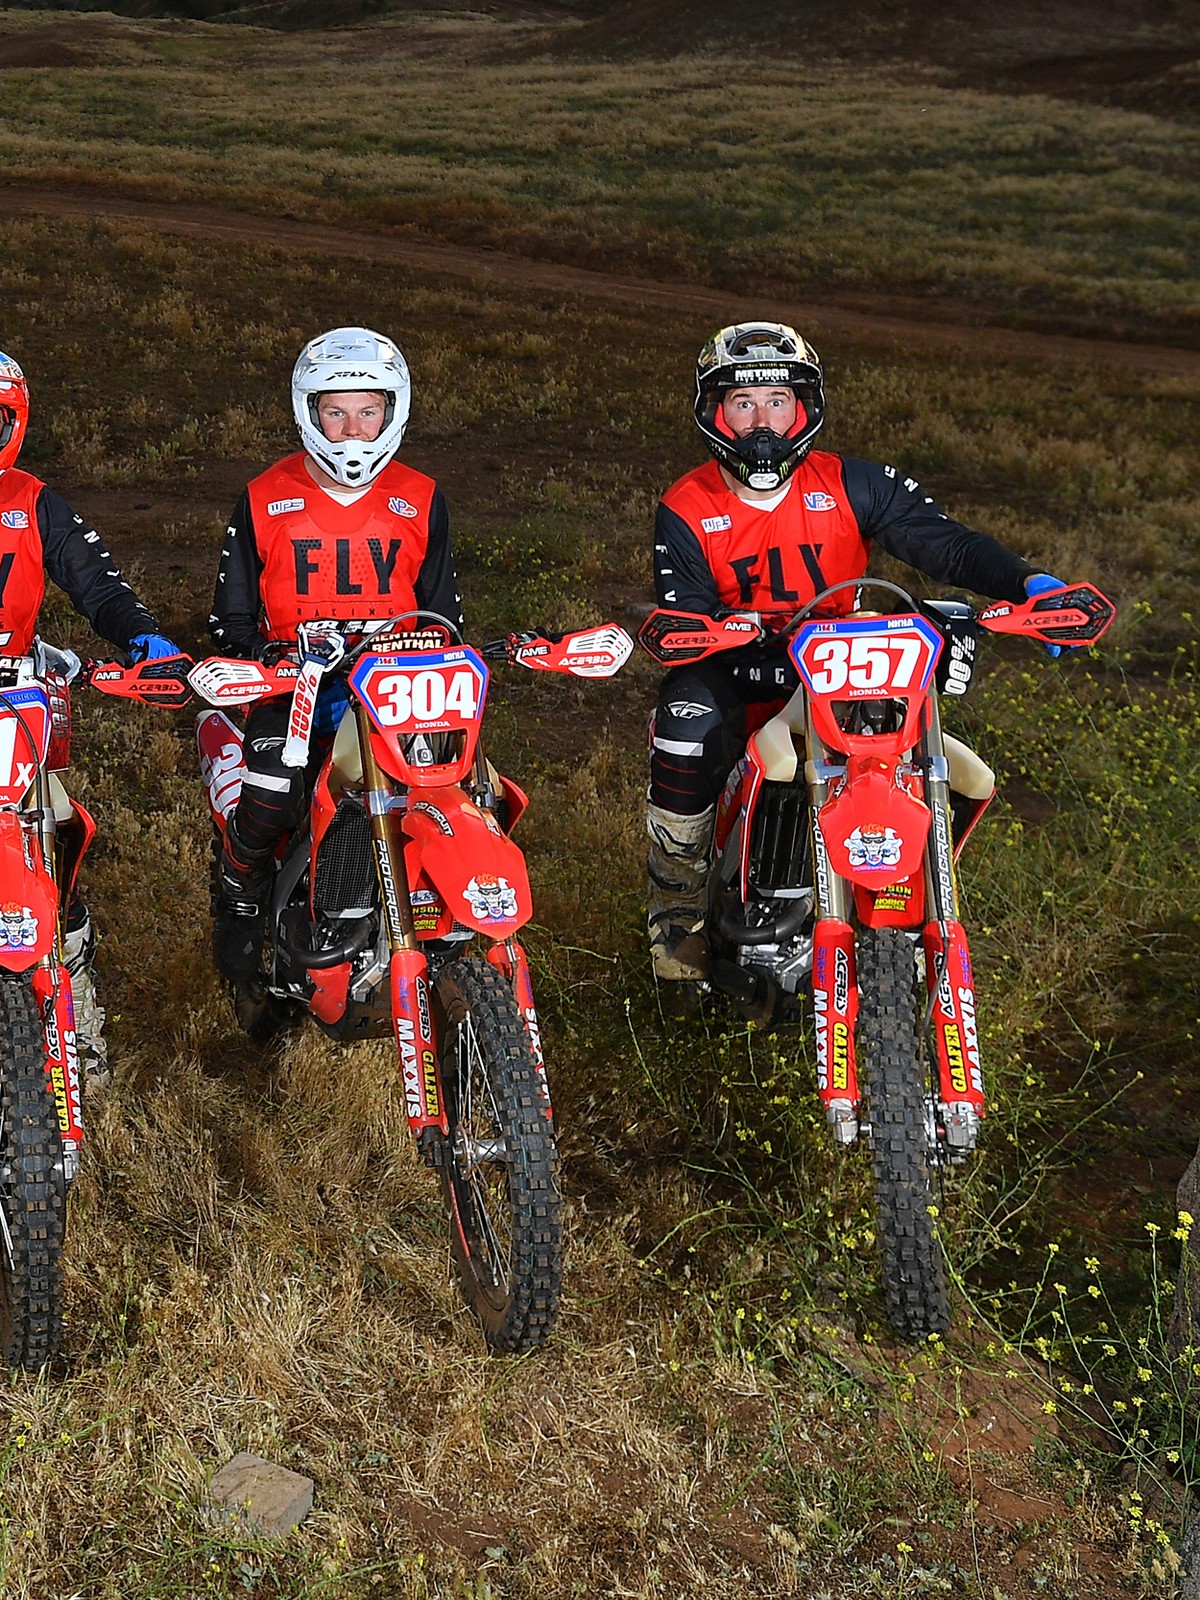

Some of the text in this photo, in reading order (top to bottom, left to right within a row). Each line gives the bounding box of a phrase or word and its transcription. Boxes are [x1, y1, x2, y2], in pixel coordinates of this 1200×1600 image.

[735, 368, 790, 378] METHOD
[291, 539, 402, 595] FLY
[729, 543, 824, 604] FLY
[725, 622, 752, 632] AME
[981, 606, 1010, 620] AME
[1022, 614, 1084, 627] ACERBIS
[372, 639, 444, 653] RENTHAL
[522, 646, 548, 658] AME
[558, 655, 613, 666] ACERBIS
[664, 637, 719, 646] ACERBIS
[811, 637, 922, 694] 357
[95, 671, 122, 680] AME
[128, 683, 181, 692] ACERBIS
[219, 685, 273, 695] ACERBIS
[377, 670, 477, 726] 304
[849, 688, 889, 697] HONDA
[290, 672, 318, 741] 100%
[414, 720, 451, 729] HONDA
[426, 805, 455, 837] CIRCUIT
[934, 801, 949, 873] CIRCUIT
[377, 838, 404, 945] PRO CIRCUIT
[815, 845, 831, 913] CIRCUIT
[415, 976, 431, 1044] ACERBIS
[834, 948, 849, 1017] ACERBIS
[813, 987, 829, 1091] MAXXIS
[832, 1021, 849, 1090] GALFER
[943, 1023, 968, 1093] GALFER
[957, 986, 984, 1094] MAXXIS
[63, 1029, 84, 1130] MAXXIS
[397, 1017, 422, 1118] MAXXIS
[421, 1050, 440, 1116] GALFER
[51, 1065, 71, 1132] GALFER
